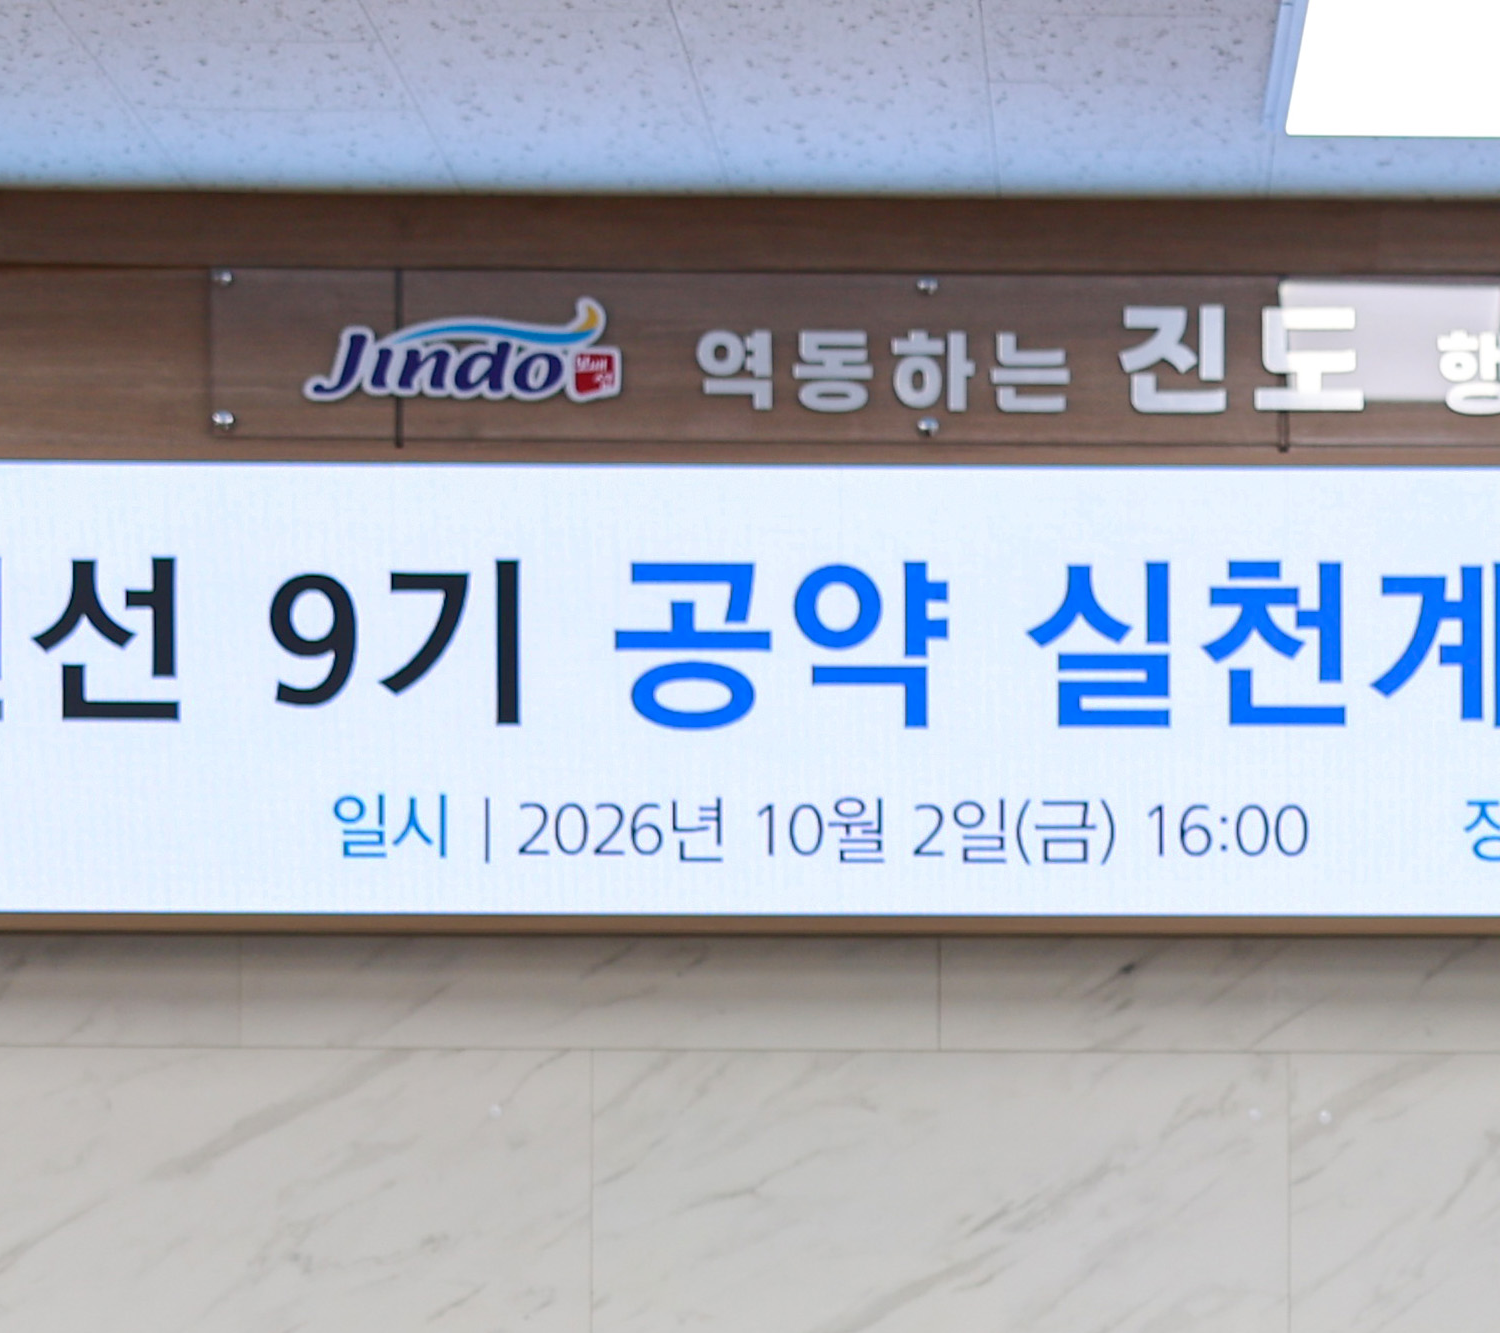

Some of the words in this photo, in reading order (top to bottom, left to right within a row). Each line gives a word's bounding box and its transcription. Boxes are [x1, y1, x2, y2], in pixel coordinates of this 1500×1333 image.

[307, 331, 565, 397] Jindo
[696, 329, 1070, 413] 역동하는
[1119, 304, 1365, 413] 진도
[269, 558, 521, 726] 9기
[614, 560, 949, 730] 공약
[332, 792, 448, 860] 일시
[517, 796, 724, 864] 2026년
[757, 796, 886, 864] 10월
[912, 797, 1117, 866] 2일(금)
[1147, 802, 1310, 858] 16:00
